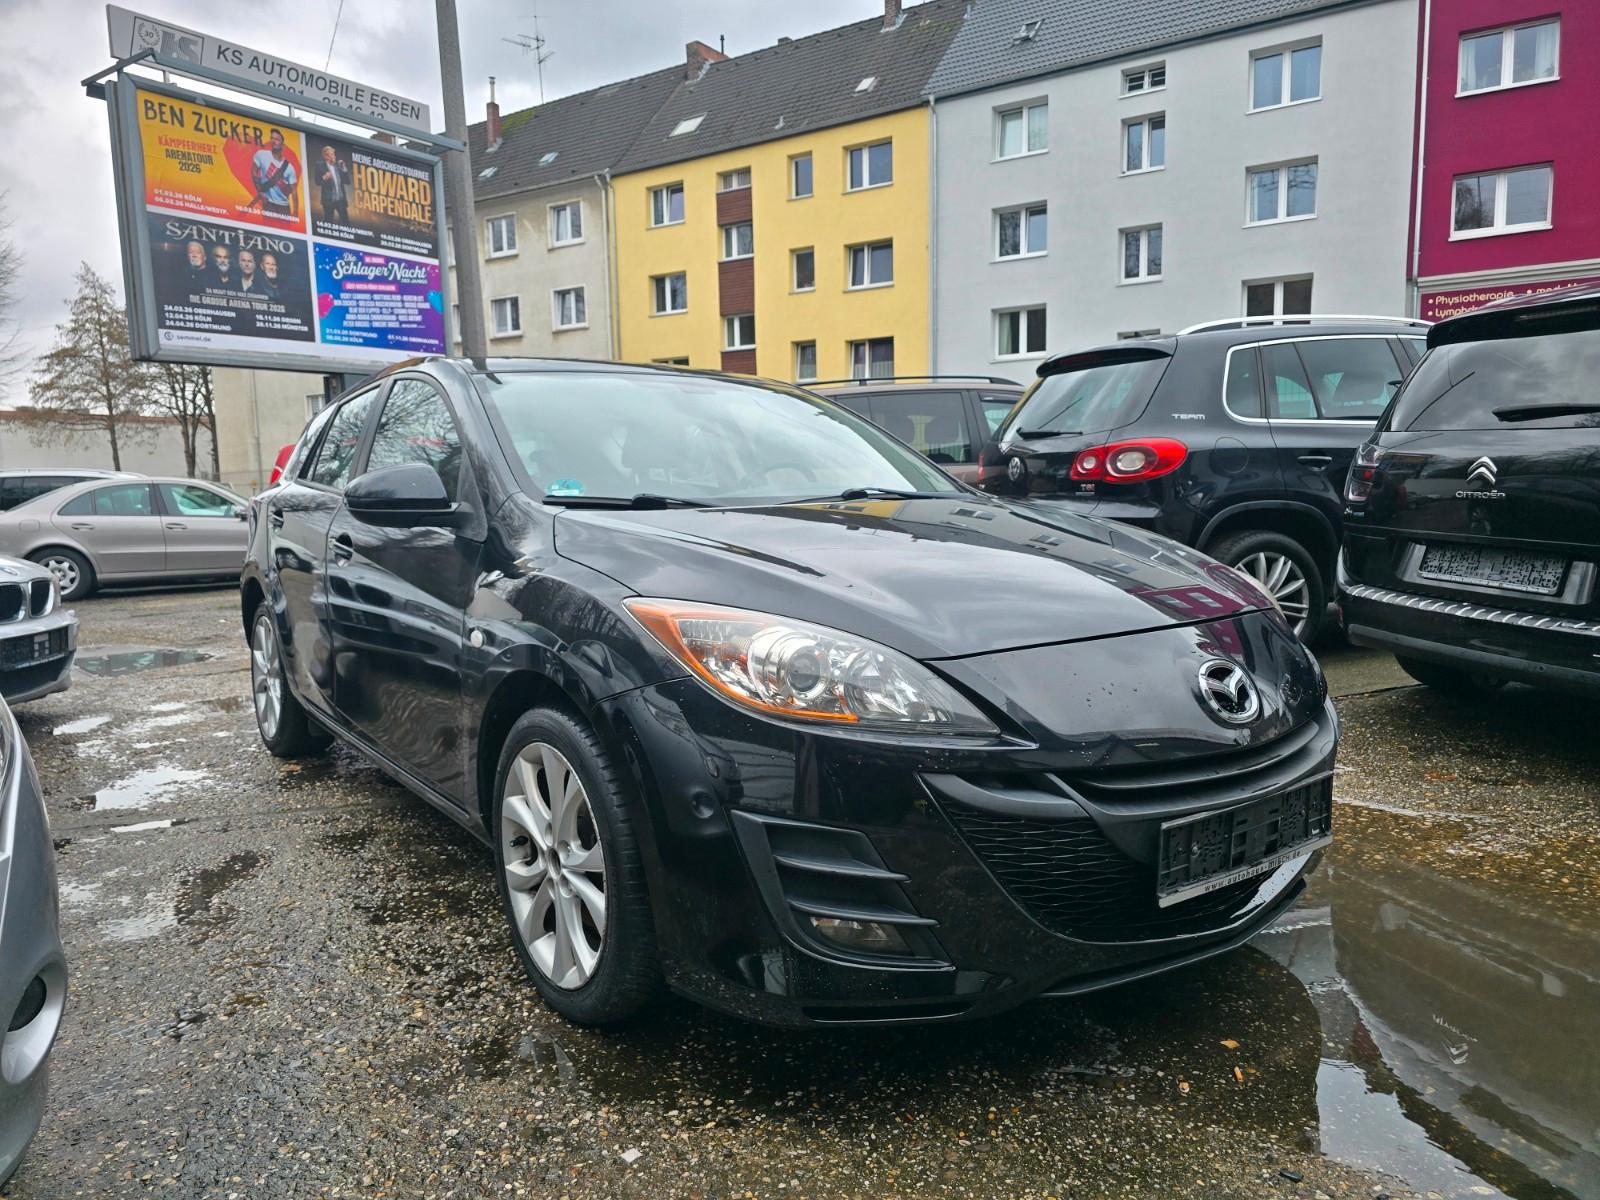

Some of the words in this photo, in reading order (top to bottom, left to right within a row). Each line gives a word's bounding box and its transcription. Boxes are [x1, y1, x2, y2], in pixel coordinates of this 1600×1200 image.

[217, 44, 244, 66] KS
[248, 56, 365, 103] AUTOMOBILE
[369, 93, 421, 121] ESSEN
[143, 99, 184, 128] BEN
[192, 111, 265, 147] ZUCKER
[158, 134, 218, 154] KÄMPFERHERZ
[165, 148, 214, 166] ARENATOUR
[352, 152, 372, 166] MEINE
[178, 161, 201, 174] 2026
[353, 162, 432, 207] HOWARD
[354, 189, 433, 225] CARPENDALE
[166, 222, 295, 255] SANTIANO
[343, 252, 357, 262] Die
[229, 299, 251, 309] ARENA
[251, 302, 268, 311] TOUR
[1435, 290, 1514, 306] Physiotherapie
[193, 307, 236, 317] OBERHAUSEN
[194, 314, 212, 323] KÖLN
[194, 322, 232, 331] DORTMUND
